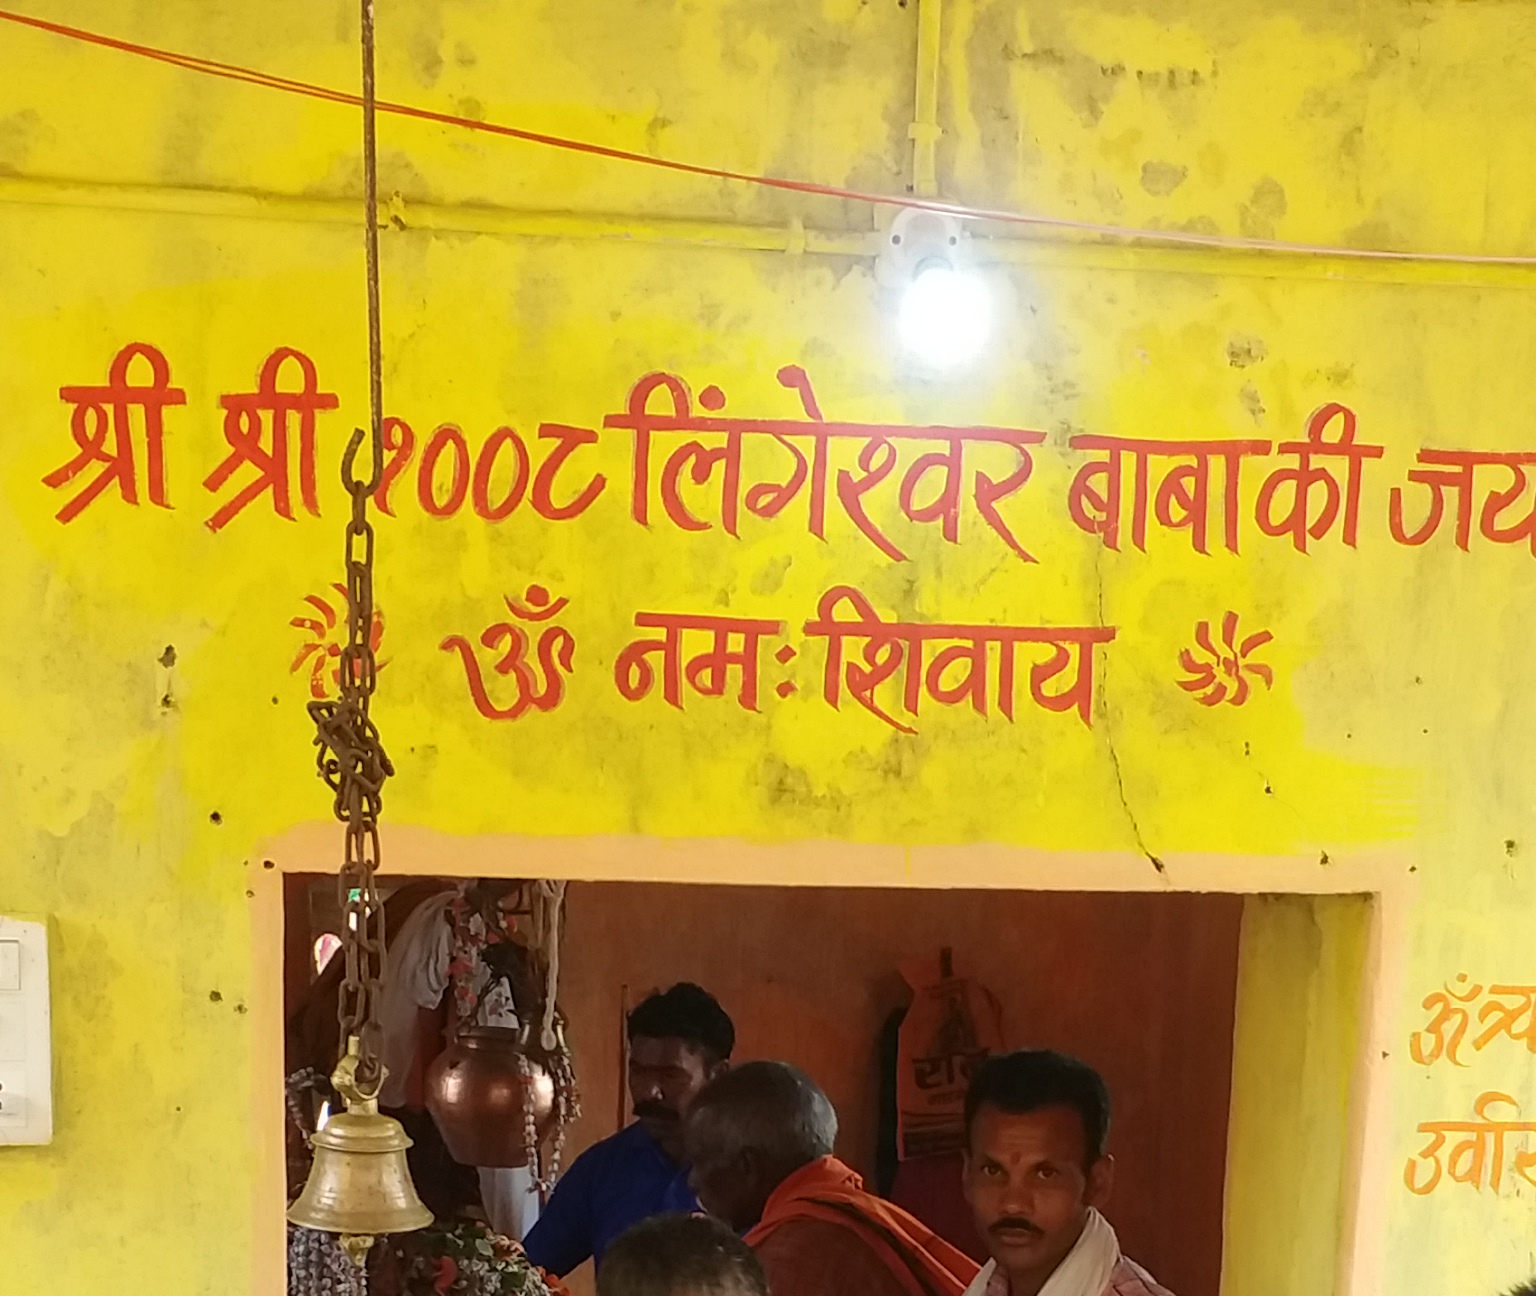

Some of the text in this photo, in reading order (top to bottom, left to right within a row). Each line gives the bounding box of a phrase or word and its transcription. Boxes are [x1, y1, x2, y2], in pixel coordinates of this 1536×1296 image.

[42, 342, 186, 525] श्री
[203, 347, 339, 534] श्री
[373, 416, 607, 523] १००८
[603, 364, 1047, 564] लिंगेश्वर
[1068, 433, 1272, 557] बाबा
[1254, 402, 1385, 557] की
[440, 584, 1116, 735] ॐ नमः शिवाय
